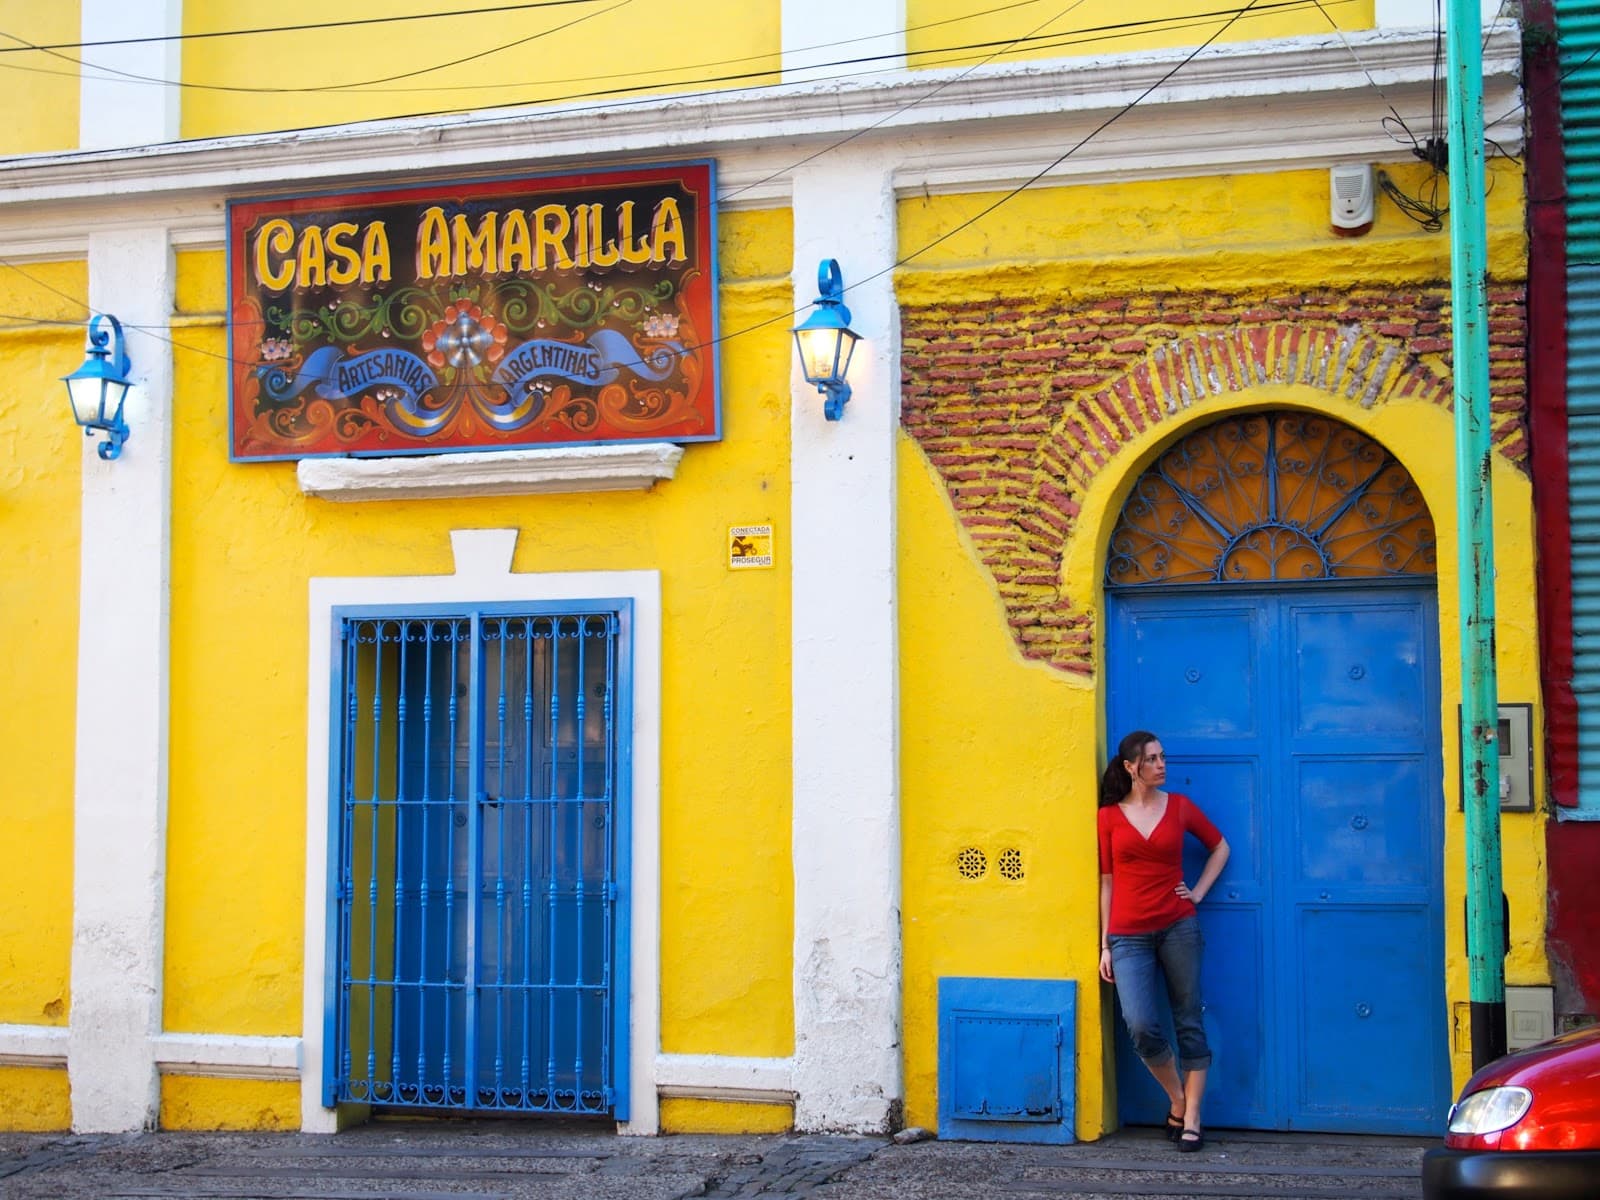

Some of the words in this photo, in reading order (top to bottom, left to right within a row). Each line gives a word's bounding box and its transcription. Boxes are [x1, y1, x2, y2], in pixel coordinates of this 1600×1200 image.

[255, 218, 392, 291] CASA
[415, 197, 688, 281] AMARILLA
[338, 353, 433, 395] ARTESANIAS
[502, 345, 601, 389] ARGENTINAS
[731, 526, 770, 534] CONECTADA
[731, 556, 771, 564] PROSEGUR
